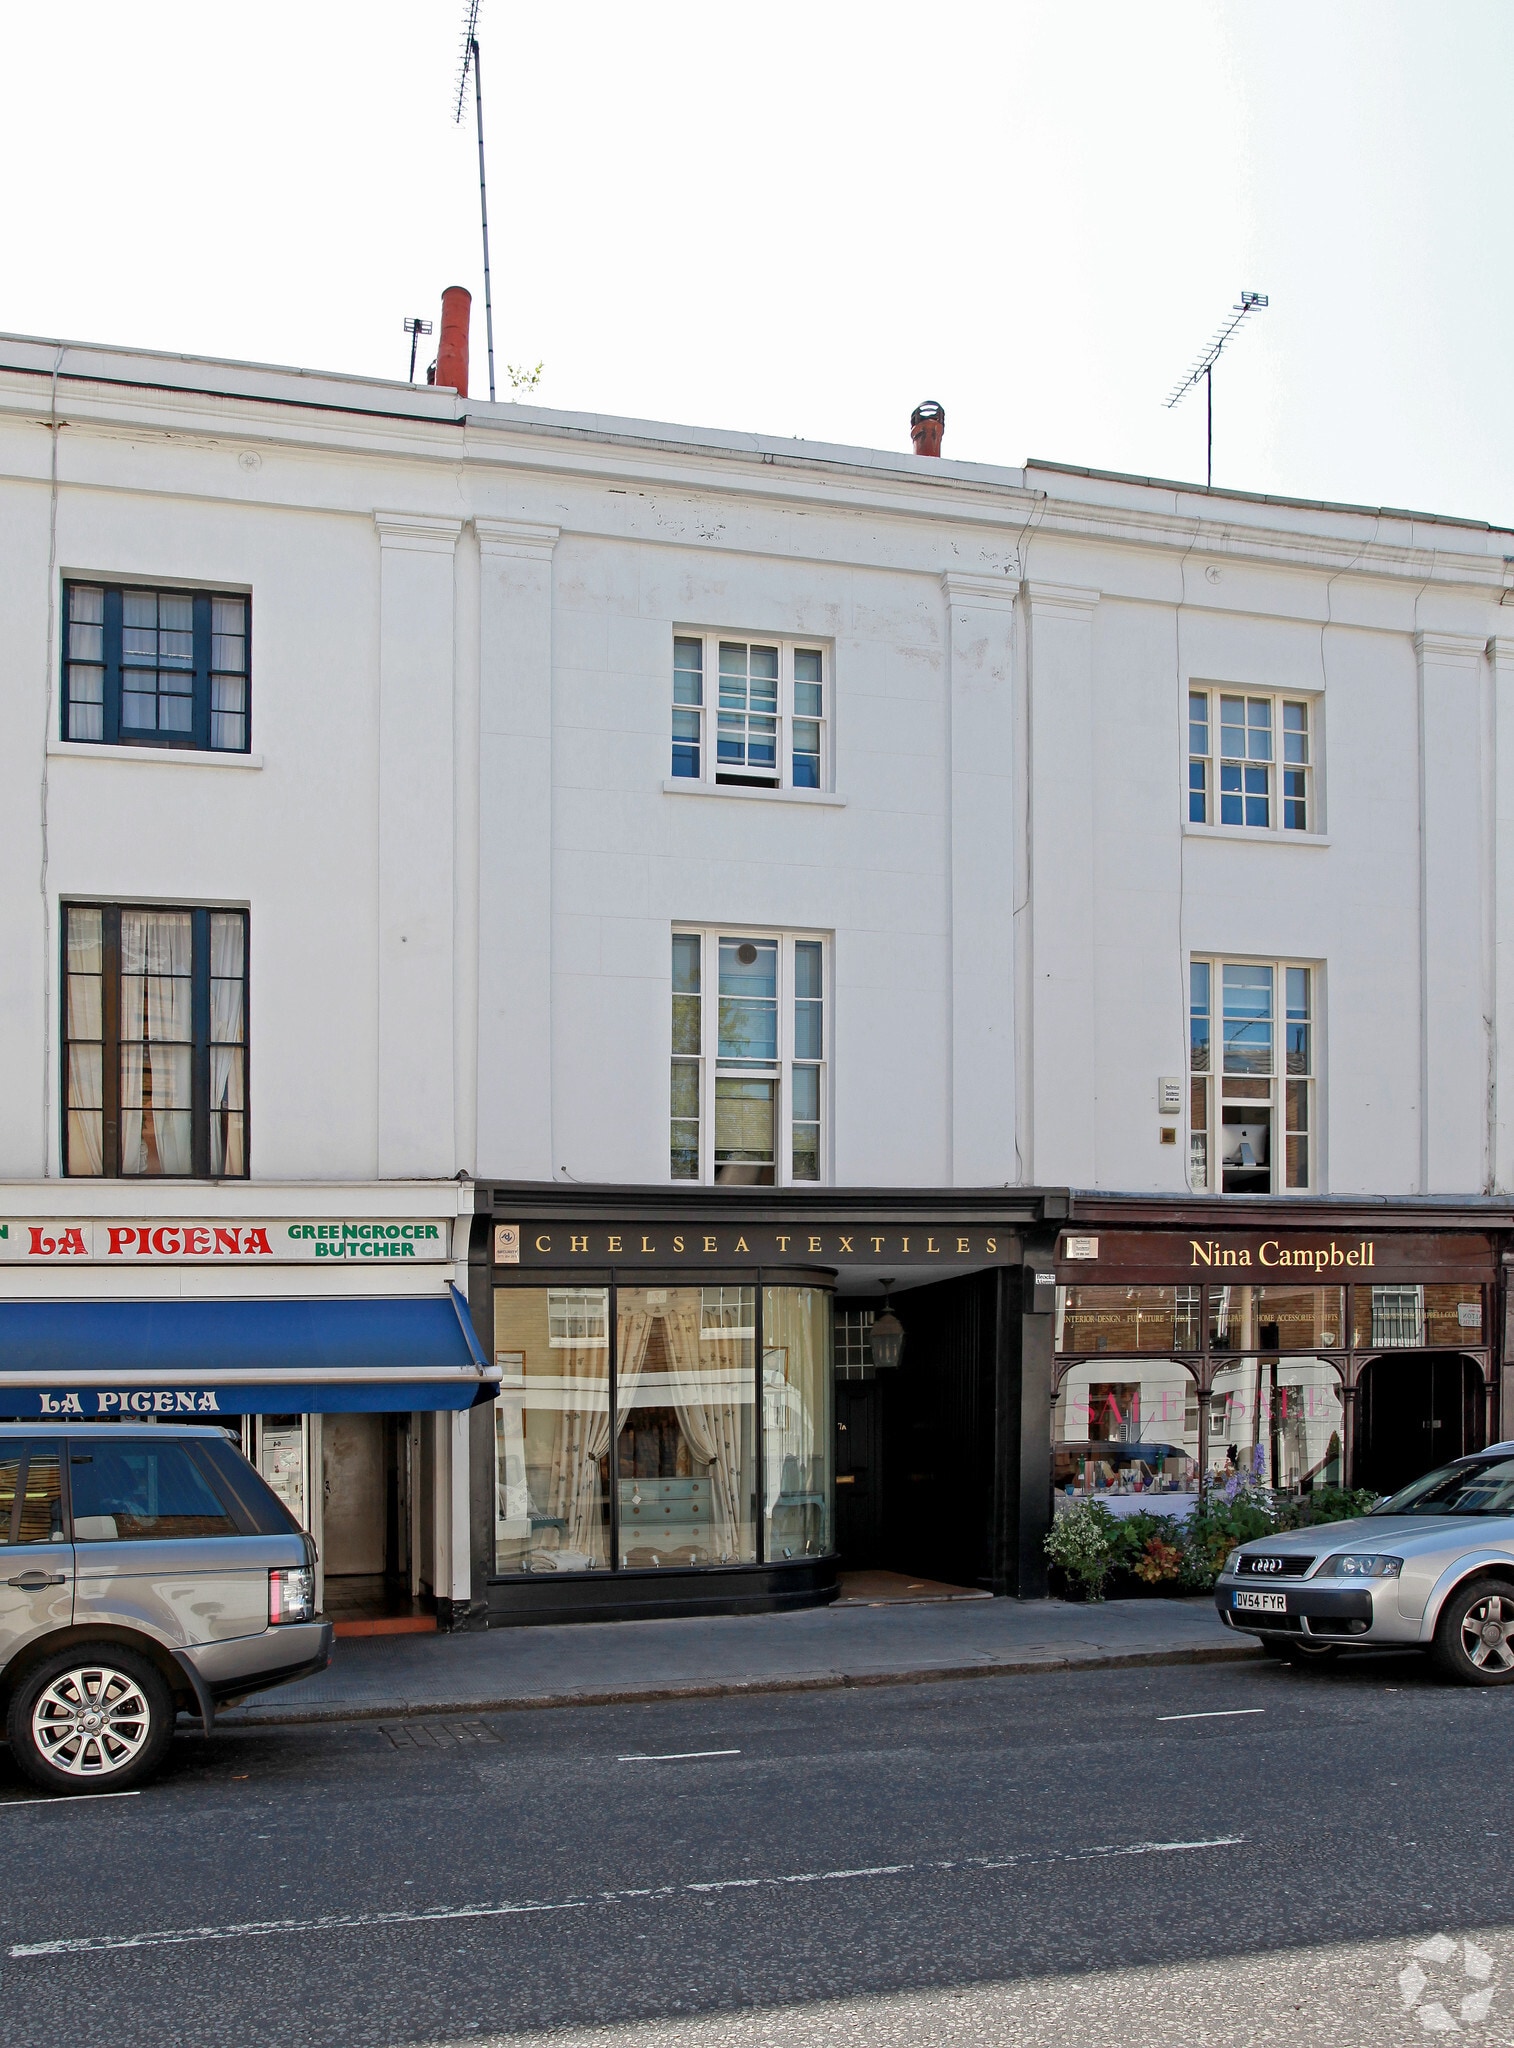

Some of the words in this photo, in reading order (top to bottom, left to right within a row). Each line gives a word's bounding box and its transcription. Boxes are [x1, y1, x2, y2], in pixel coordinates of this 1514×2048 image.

[28, 1227, 88, 1255] LA
[107, 1227, 273, 1255] PICENA
[287, 1224, 439, 1240] GREENGROCER
[314, 1242, 415, 1257] BUTCHER
[535, 1235, 750, 1252] CHELSEA
[776, 1236, 998, 1253] TEXTILES
[1190, 1241, 1253, 1266] Nina
[1258, 1240, 1375, 1272] Campbell
[1097, 1314, 1121, 1323] DESIGN
[1256, 1314, 1275, 1322] HOME
[39, 1393, 84, 1413] LA
[97, 1391, 220, 1412] PICENA
[1072, 1390, 1185, 1425] SALE
[1226, 1387, 1331, 1420] SALE
[1237, 1593, 1260, 1608] DV54
[1262, 1596, 1285, 1609] FYR
